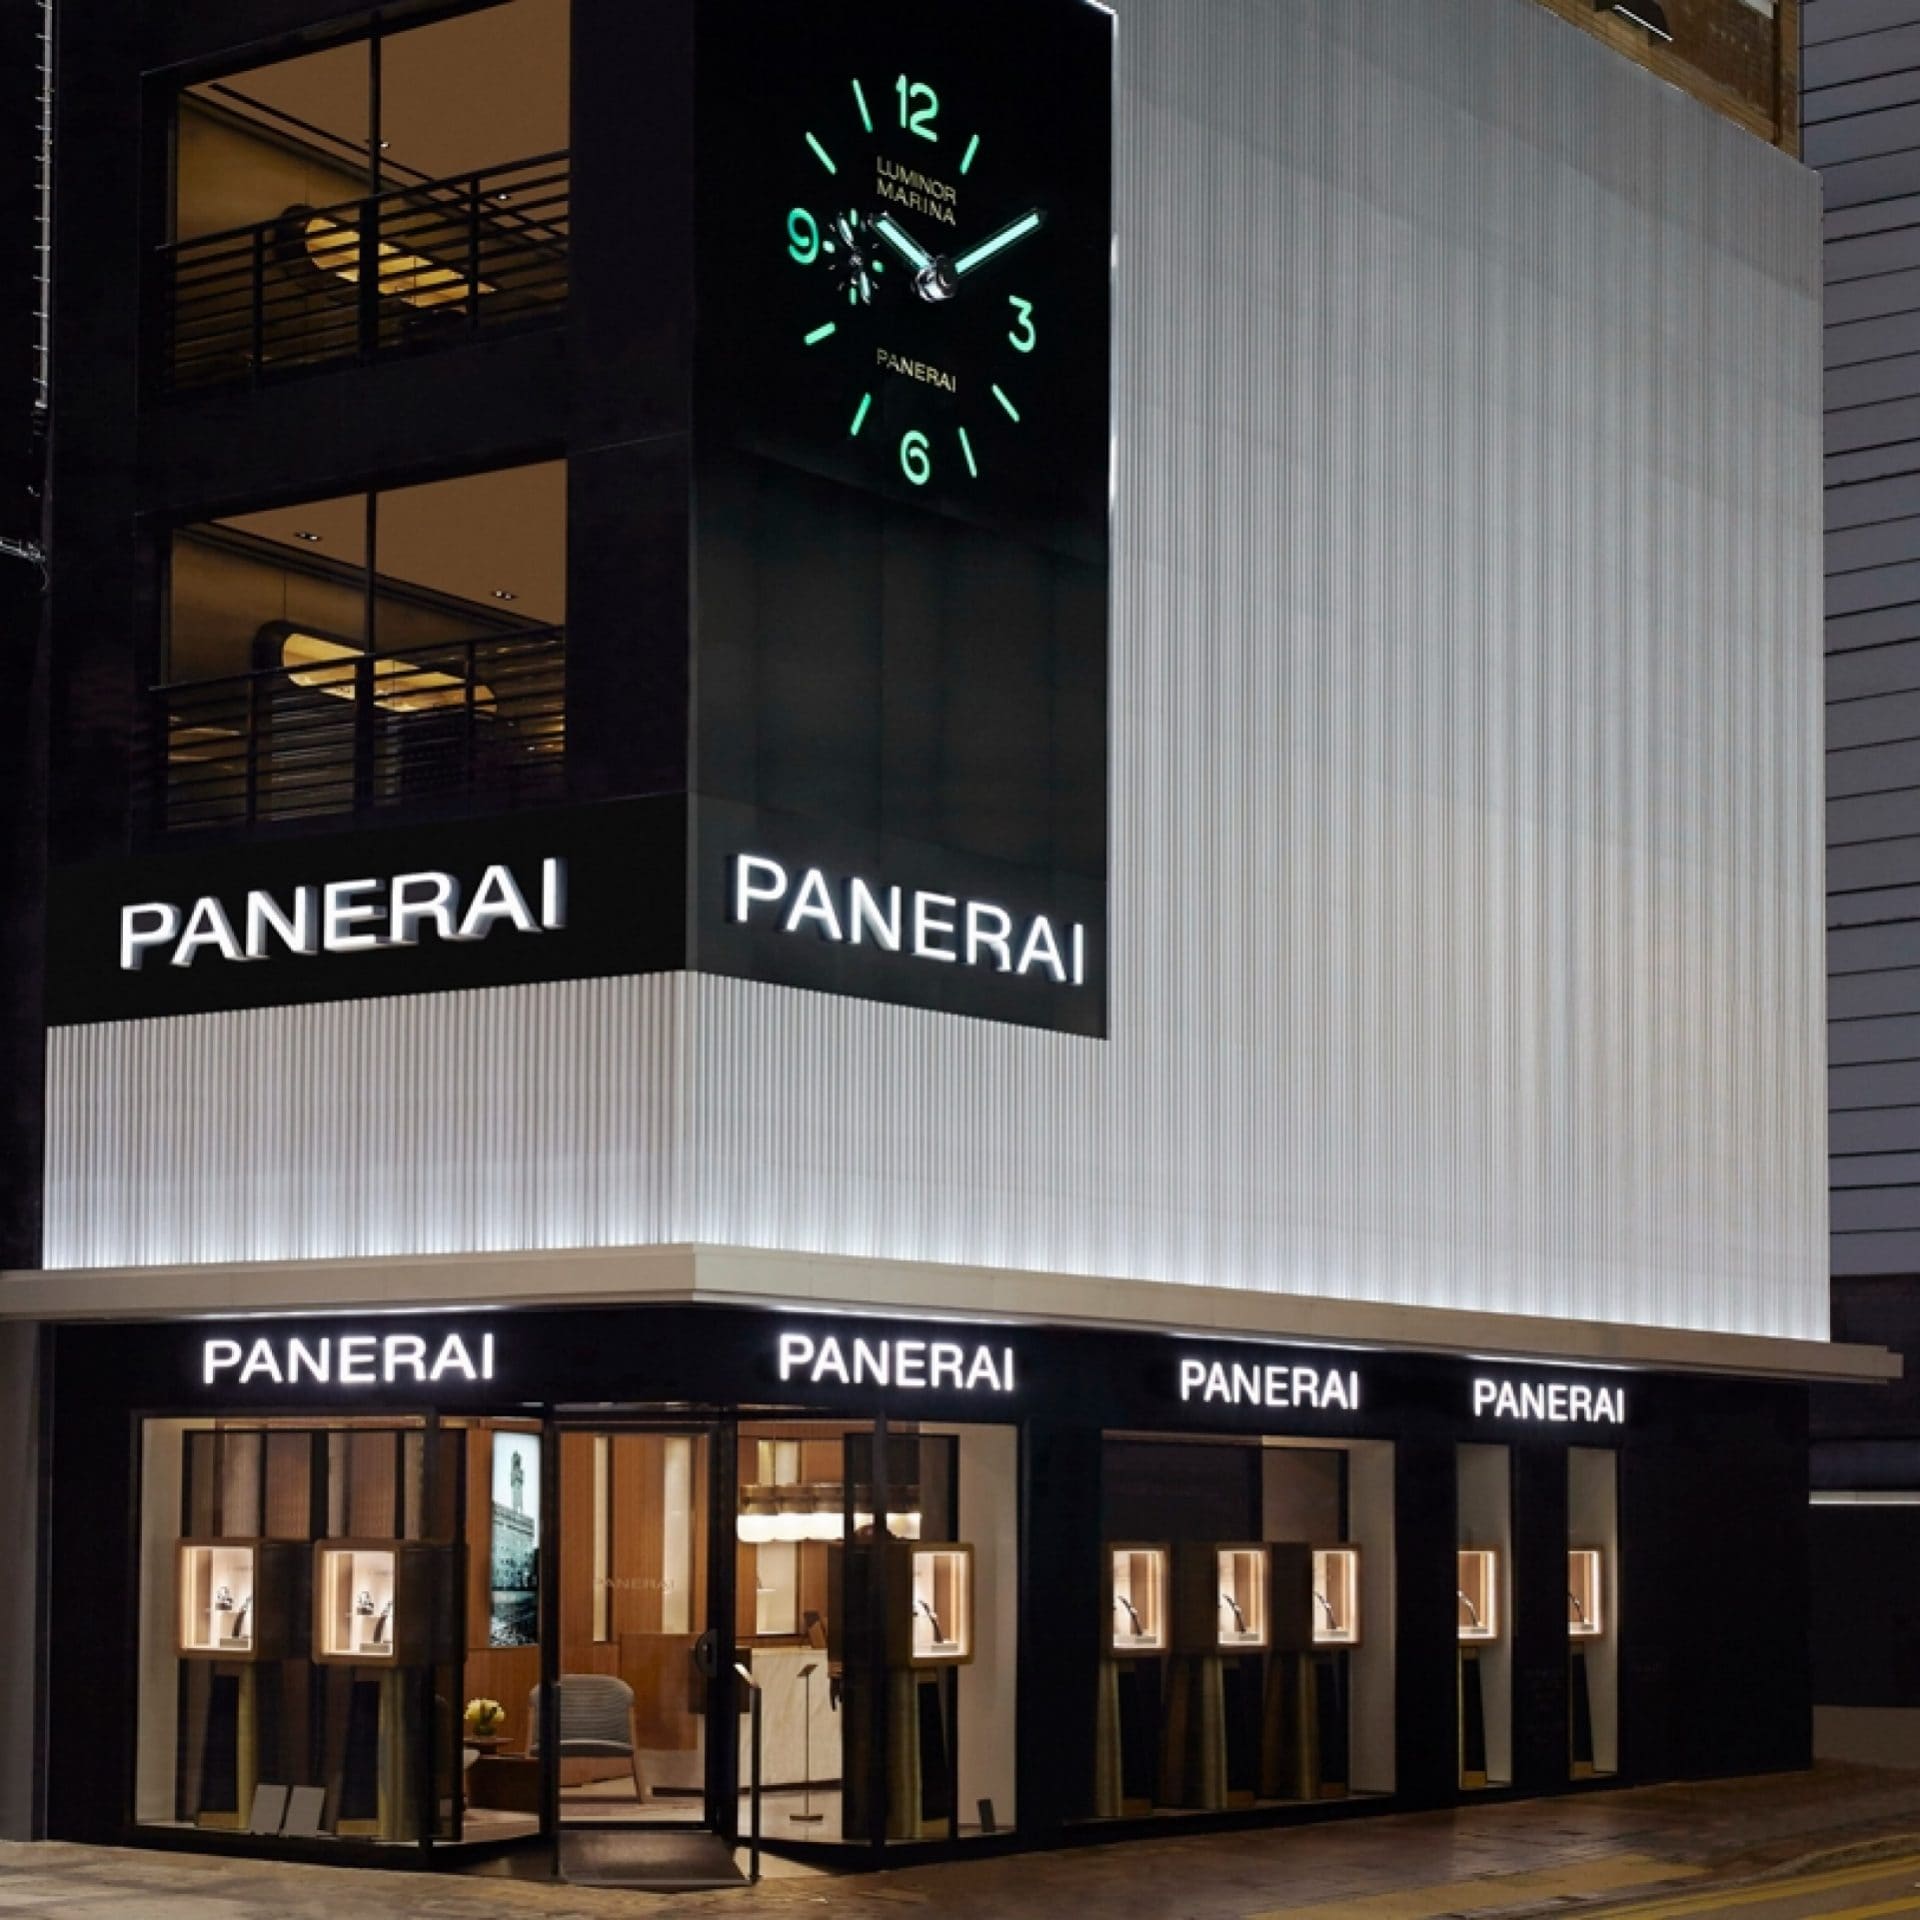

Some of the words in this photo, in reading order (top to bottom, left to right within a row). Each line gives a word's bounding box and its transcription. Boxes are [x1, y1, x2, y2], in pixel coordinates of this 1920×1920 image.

[896, 74, 938, 142] 12
[876, 155, 957, 206] LUMINOR
[876, 179, 957, 227] MARINA
[787, 208, 819, 264] 9
[1009, 295, 1036, 353] 3
[876, 347, 957, 393] PANERAI
[900, 430, 930, 485] 6
[120, 857, 567, 970] PANERAI
[731, 852, 1086, 986] PANERAI
[203, 1332, 494, 1384] PANERAI
[779, 1333, 1015, 1392] PANERAI
[1180, 1359, 1359, 1410] PANERAI
[1473, 1378, 1625, 1424] PANERAI
